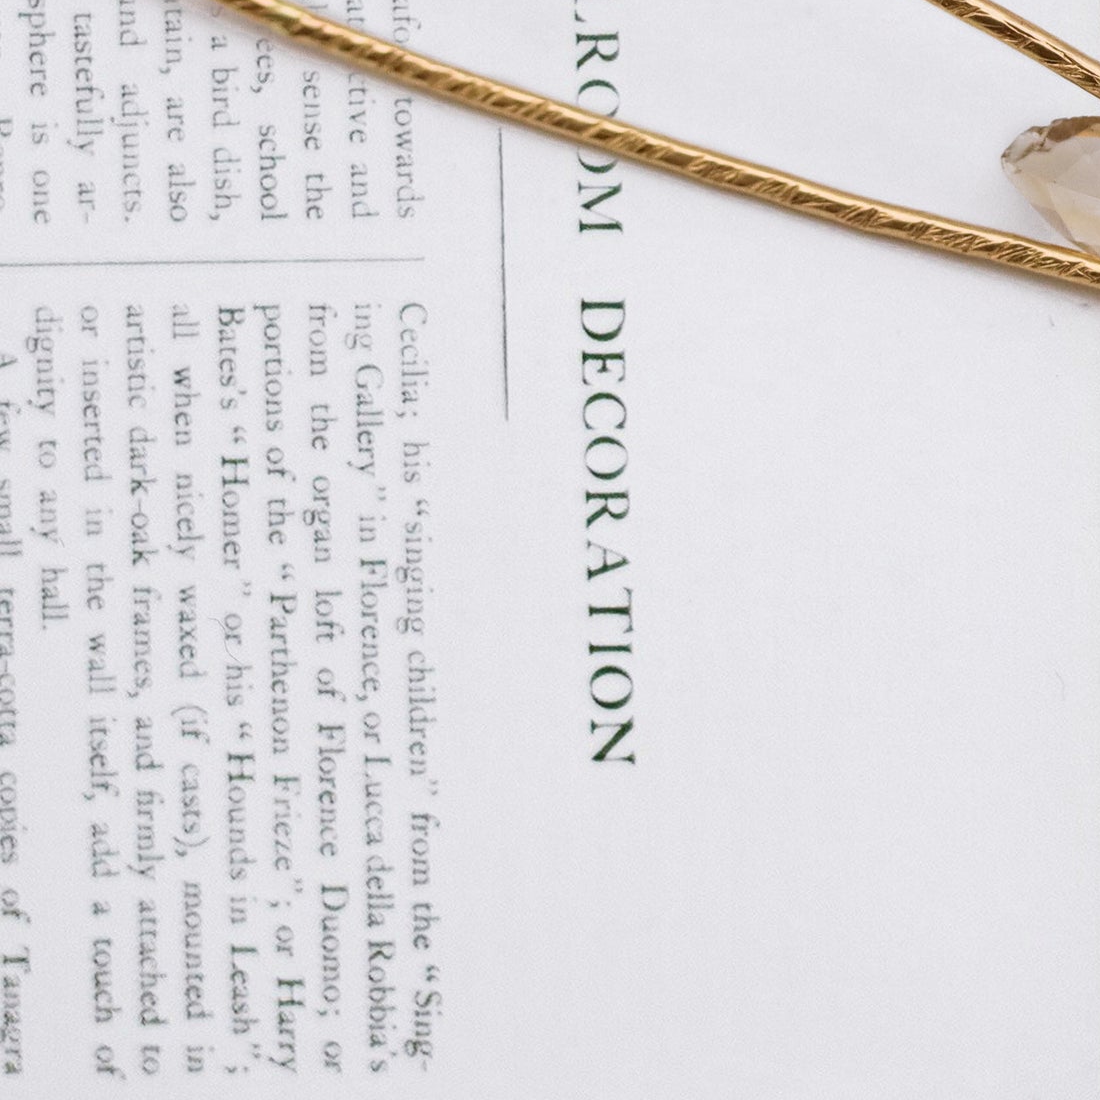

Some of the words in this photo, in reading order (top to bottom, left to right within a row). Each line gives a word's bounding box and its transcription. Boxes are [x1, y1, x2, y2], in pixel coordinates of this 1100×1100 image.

[210, 36, 227, 51] a
[66, 12, 104, 156] tastefully
[211, 67, 240, 129] bird
[302, 71, 321, 151] sense
[31, 123, 58, 145] is
[165, 97, 184, 142] are
[110, 84, 149, 223] adjuncts.
[208, 147, 241, 221] dish,
[258, 125, 288, 221] school
[394, 98, 425, 219] towards
[32, 170, 49, 224] one
[77, 182, 95, 223] ar-
[167, 164, 196, 223] also
[305, 173, 332, 220] the
[350, 164, 379, 219] and
[80, 306, 98, 337] or
[171, 304, 199, 340] all
[308, 303, 338, 377] from
[344, 304, 381, 351] ing
[25, 306, 62, 416] dignity
[125, 305, 155, 407] artistic
[217, 306, 247, 410] Bates's
[252, 303, 291, 432] portions
[395, 302, 429, 418] Cecilia;
[81, 360, 112, 482] inserted
[172, 367, 200, 446] when
[310, 403, 337, 451] the
[37, 440, 57, 469] to
[265, 447, 296, 482] of
[403, 442, 430, 484] his
[30, 490, 58, 543] any
[85, 509, 112, 537] in
[128, 426, 159, 567] dark-oak
[166, 473, 204, 560] nicely
[267, 498, 294, 545] the
[302, 475, 331, 563] organ
[358, 515, 386, 543] in
[579, 297, 637, 766] DECORATION
[40, 567, 69, 630] hall.
[85, 563, 113, 610] the
[314, 590, 345, 643] loft
[127, 587, 161, 699] frames,
[177, 586, 207, 679] waxed
[355, 558, 388, 702] Florence,
[87, 634, 116, 694] wall
[225, 664, 252, 707] his
[316, 668, 346, 702] of
[133, 716, 164, 772] and
[170, 706, 210, 744] (if
[362, 712, 381, 744] or
[82, 717, 119, 801] itself,
[317, 722, 345, 857] Florence
[173, 764, 209, 858] casts),
[363, 755, 392, 846] Lucca
[89, 823, 119, 878] add
[127, 790, 165, 880] firmly
[410, 812, 441, 886] from
[91, 902, 110, 916] a
[229, 896, 256, 925] in
[365, 855, 394, 928] della
[182, 881, 213, 1021] mounted
[275, 925, 294, 957] or
[316, 884, 349, 1017] Duomo;
[411, 902, 440, 950] the
[90, 938, 122, 1024] touch
[137, 900, 168, 1027] attached
[268, 977, 305, 1073] Harry
[366, 940, 397, 1073] Robbia's
[94, 1045, 126, 1080] of
[140, 1045, 161, 1076] to
[185, 1045, 214, 1073] in
[322, 1040, 342, 1073] or
